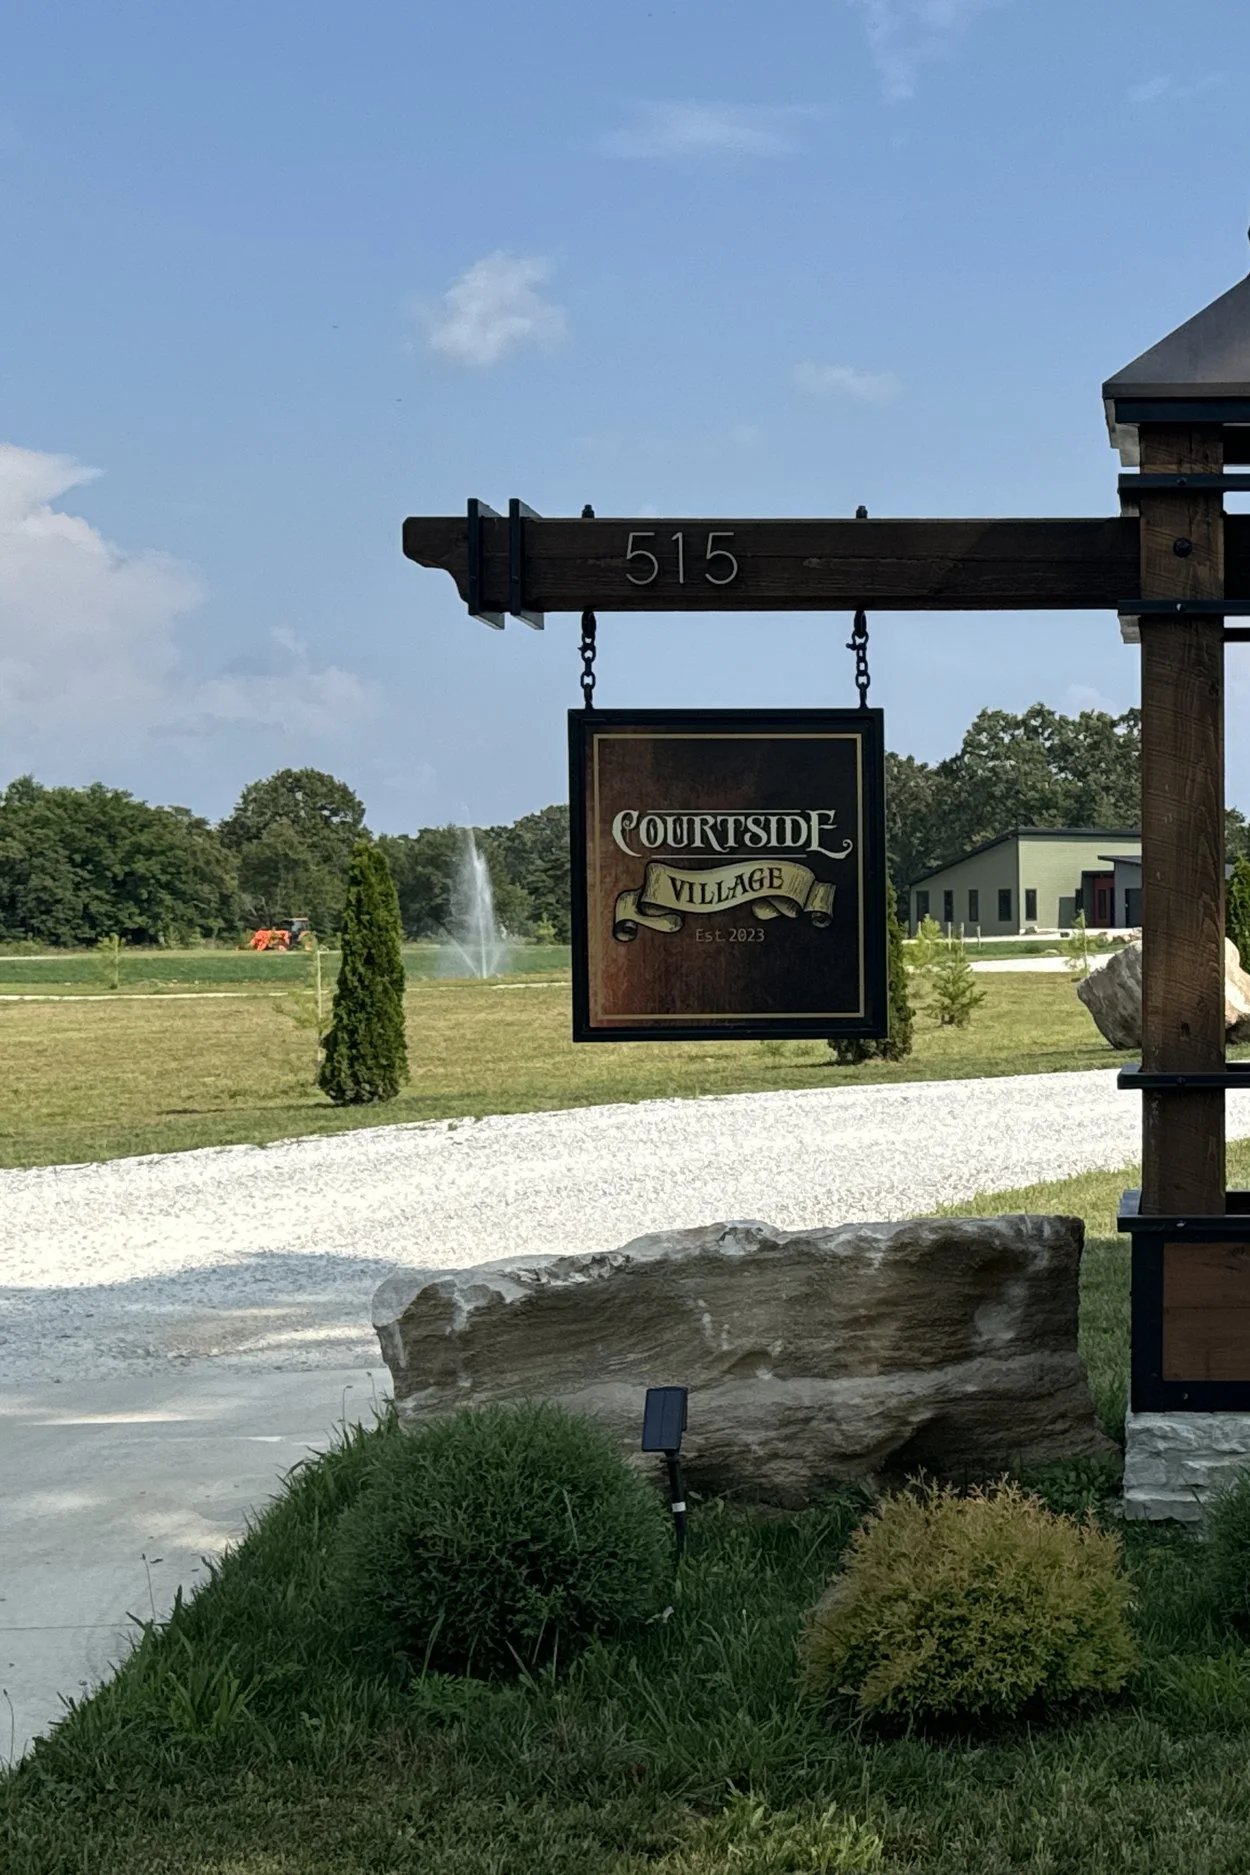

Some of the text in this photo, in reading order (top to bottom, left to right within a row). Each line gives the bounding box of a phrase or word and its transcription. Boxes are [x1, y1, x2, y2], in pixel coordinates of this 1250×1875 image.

[626, 531, 738, 585] 515
[612, 809, 853, 859] COURTSIDE
[668, 867, 784, 905] VILLAGE
[728, 928, 765, 942] 2023
